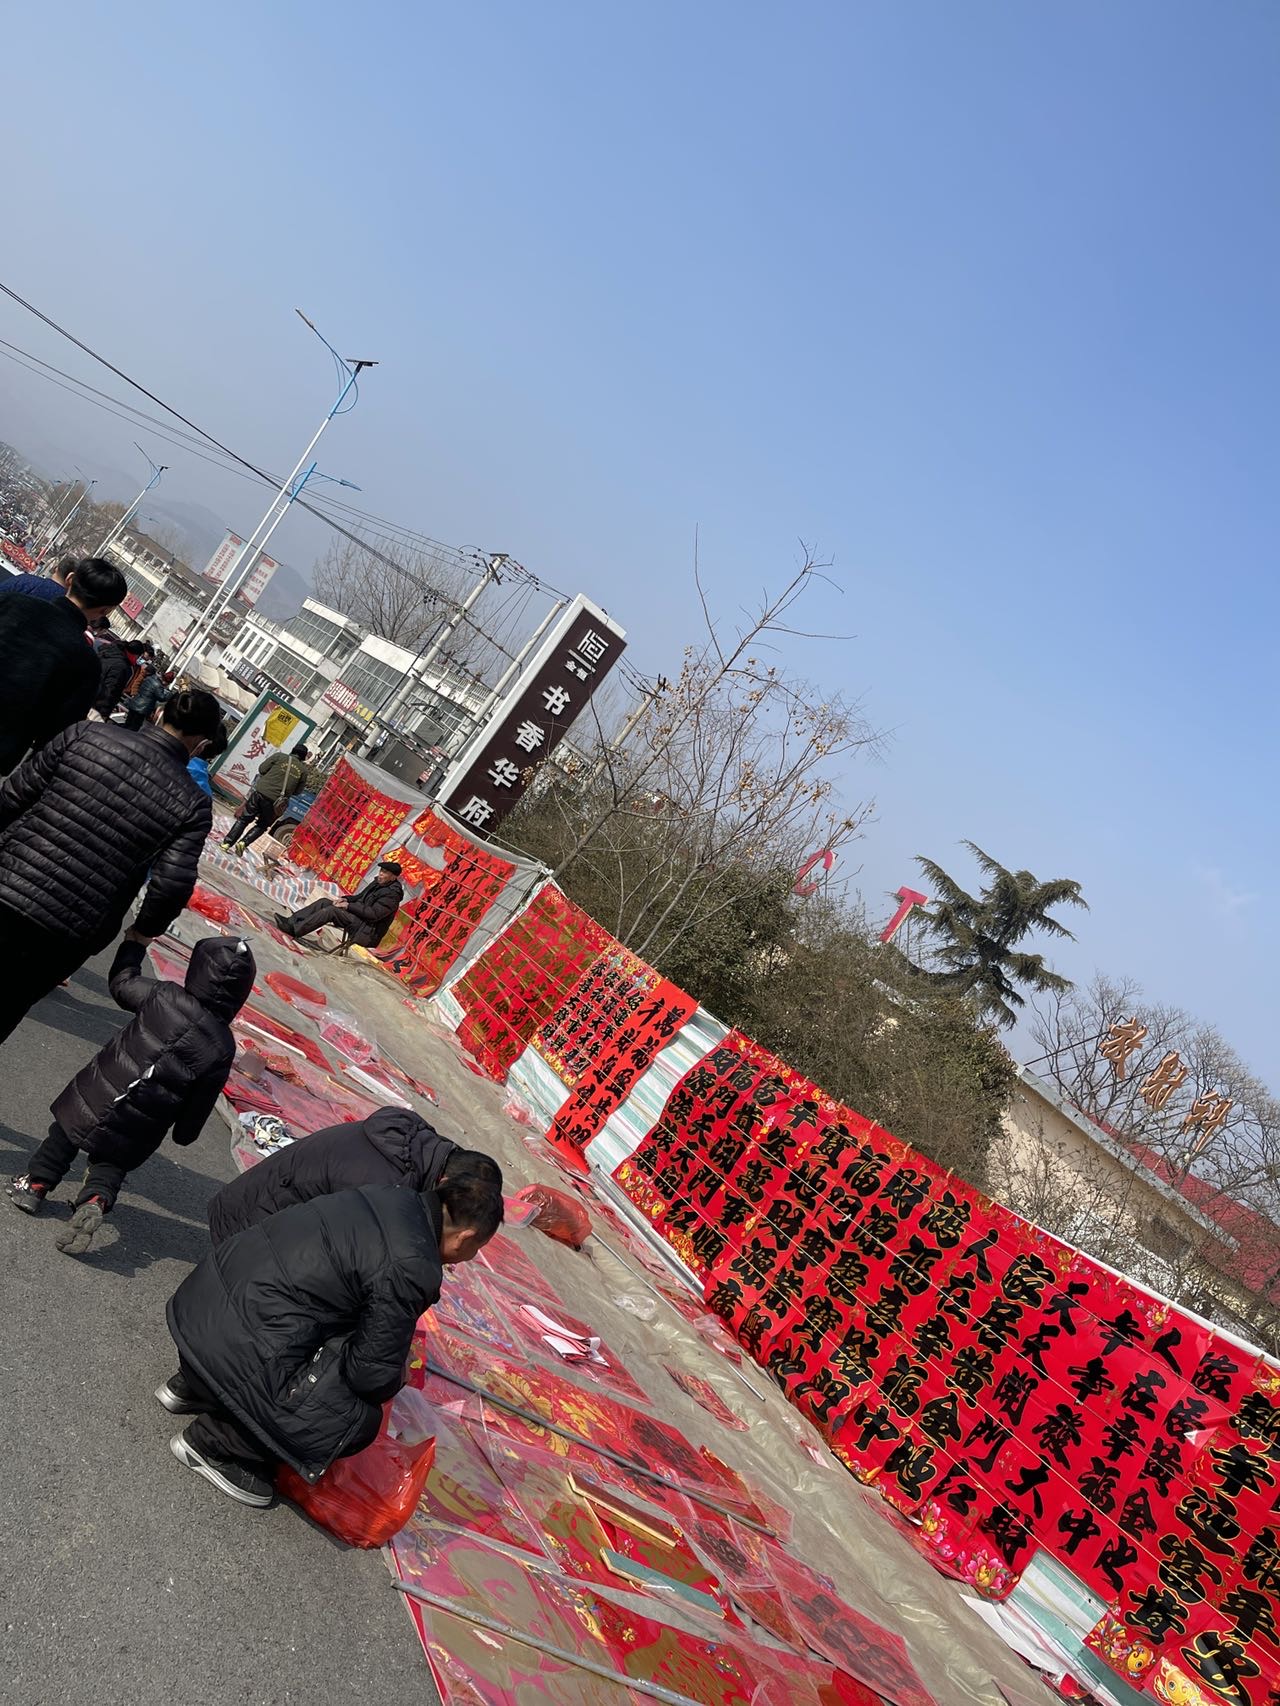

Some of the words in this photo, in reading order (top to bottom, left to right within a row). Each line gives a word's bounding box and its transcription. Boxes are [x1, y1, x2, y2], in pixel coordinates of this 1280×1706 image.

[457, 681, 573, 829] 书香华府
[563, 658, 588, 682] 金恒
[853, 1229, 999, 1451] 人在幸福中
[1057, 1327, 1182, 1556] 人在幸福中
[1181, 1495, 1280, 1701] 報平安
